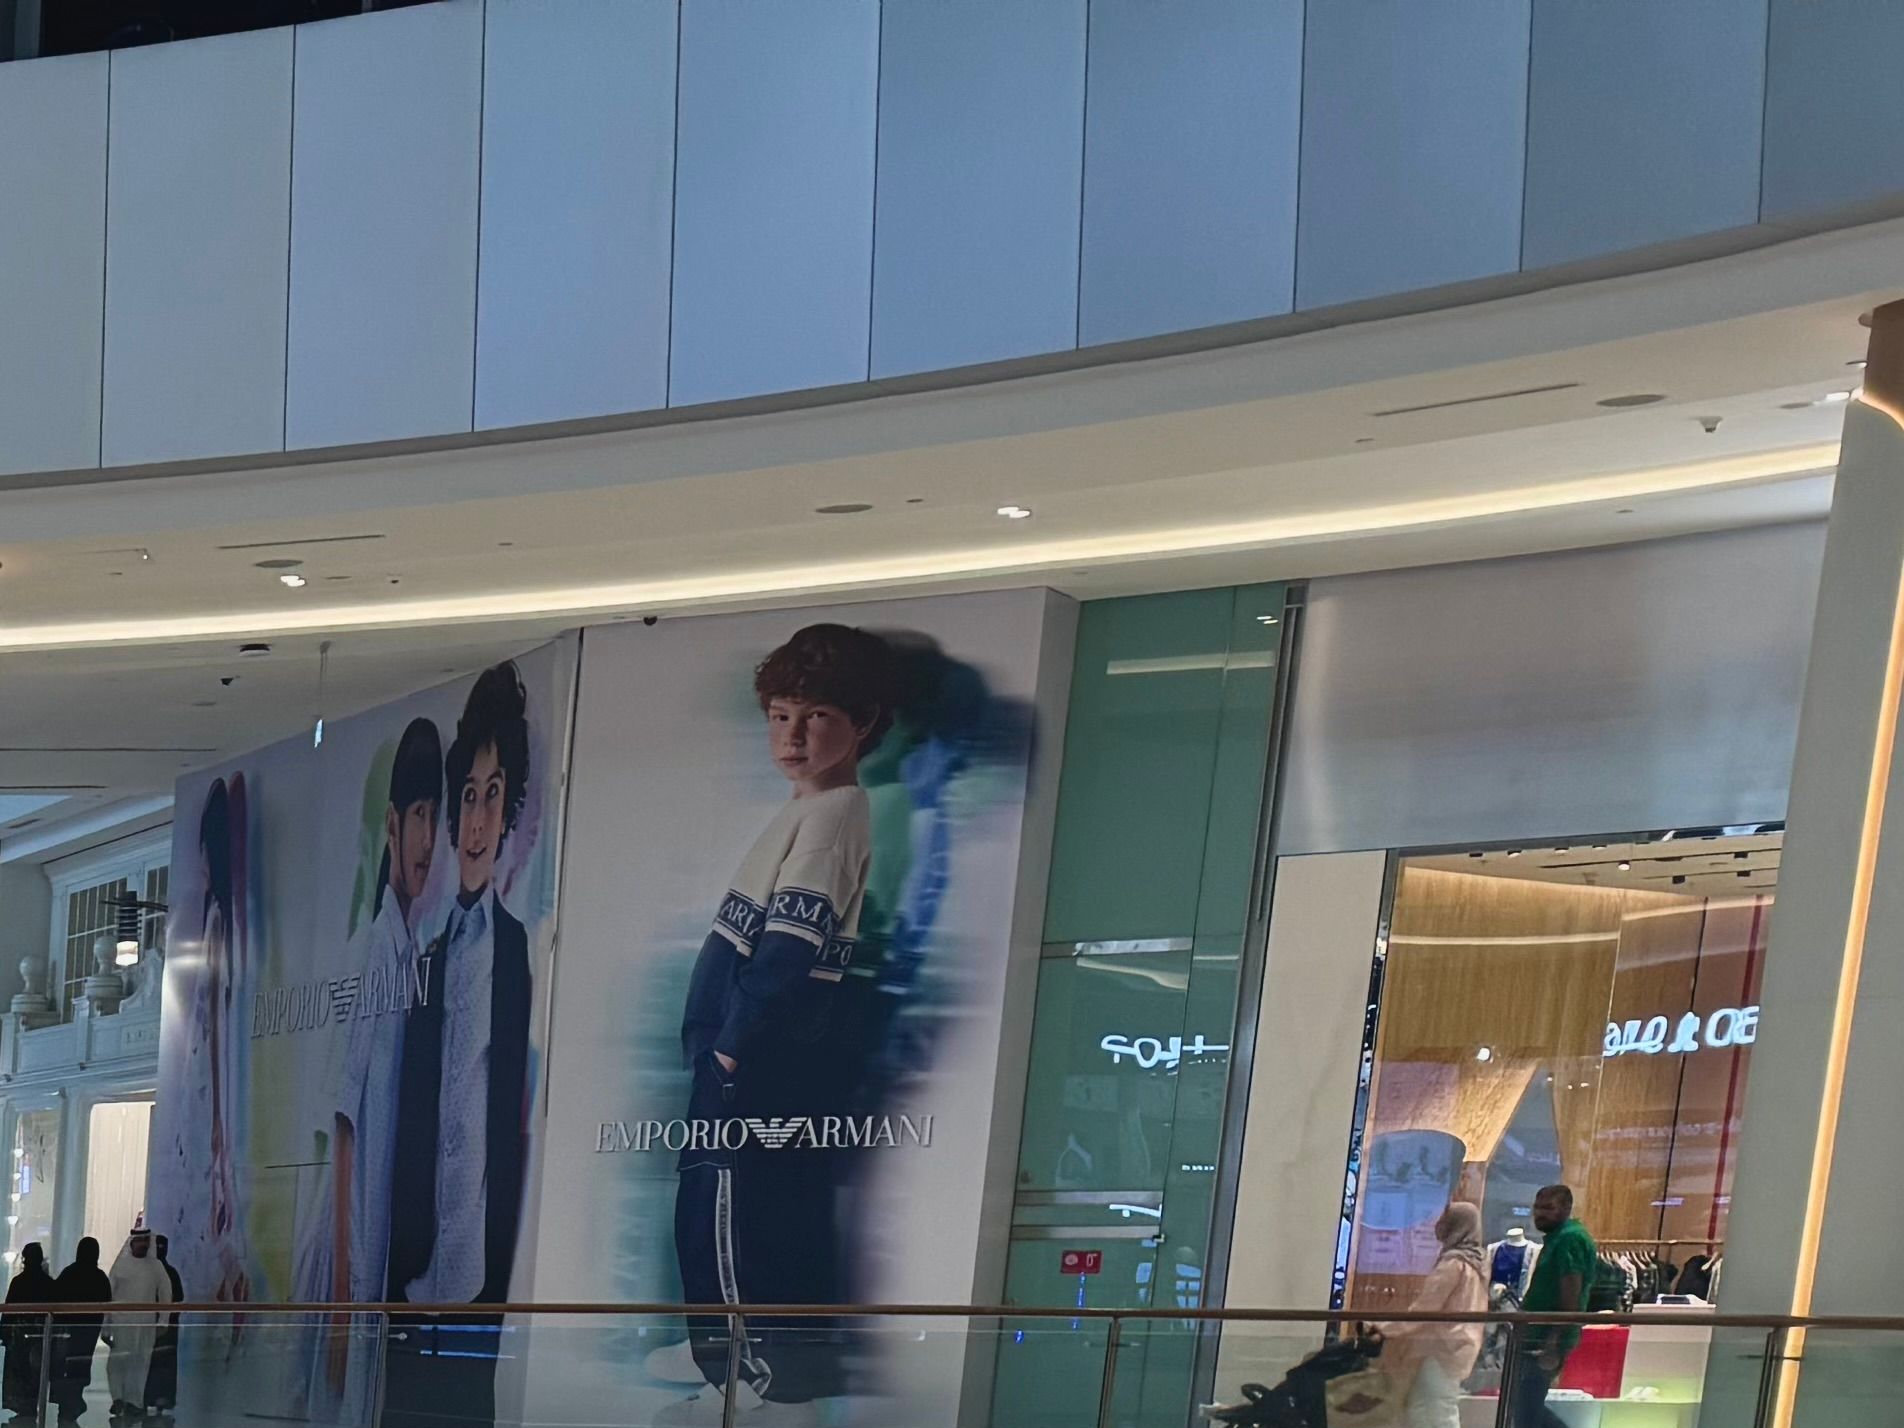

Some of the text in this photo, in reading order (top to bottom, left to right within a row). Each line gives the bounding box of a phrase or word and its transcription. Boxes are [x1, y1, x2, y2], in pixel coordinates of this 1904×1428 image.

[251, 956, 431, 1040] EMPORIO ARMANI
[594, 1114, 935, 1152] EMPORIO ARMANI
